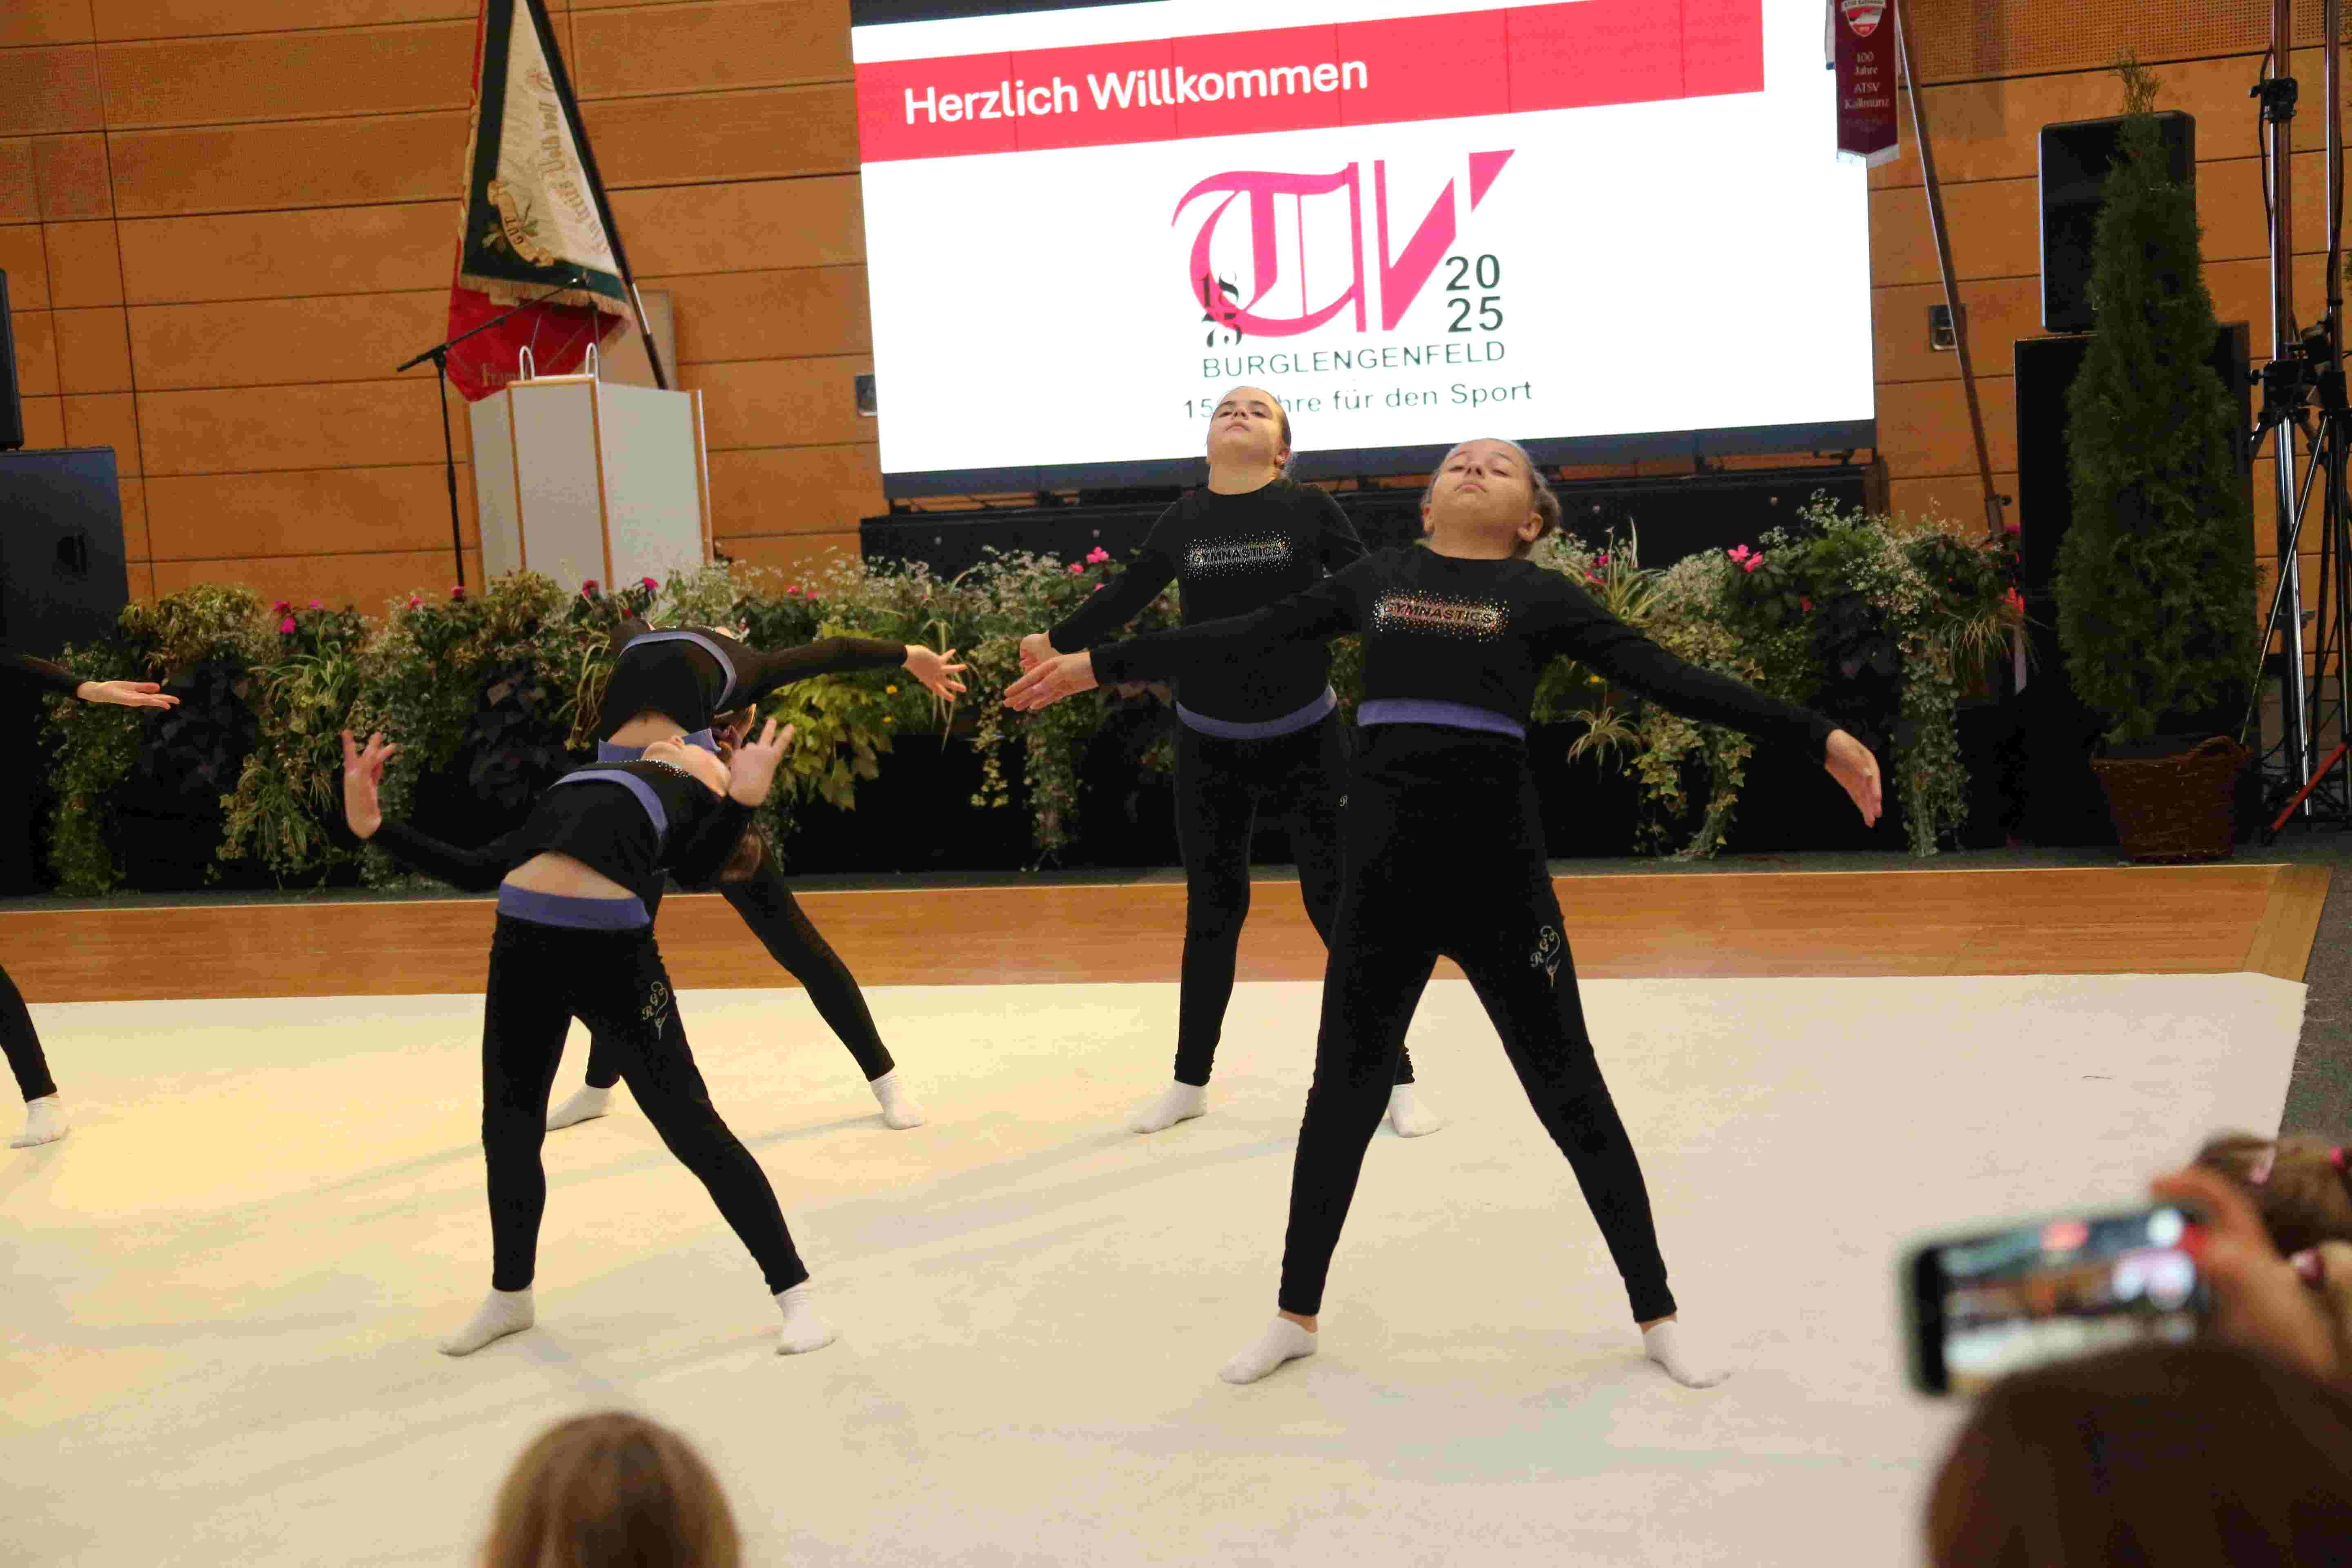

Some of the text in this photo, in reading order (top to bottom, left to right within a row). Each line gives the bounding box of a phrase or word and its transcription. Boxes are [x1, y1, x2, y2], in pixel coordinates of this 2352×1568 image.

[904, 60, 1369, 124] Herzlich Willkommen
[1853, 82, 1880, 94] ATSV
[1446, 253, 1501, 292] 20
[1447, 296, 1504, 333] 25
[1202, 341, 1505, 379] BURGLENGENFELD
[1183, 381, 1533, 419] 15 hre für den Sport
[1191, 543, 1284, 565] GYMNASTICS
[1383, 601, 1496, 625] GYMNASTICS
